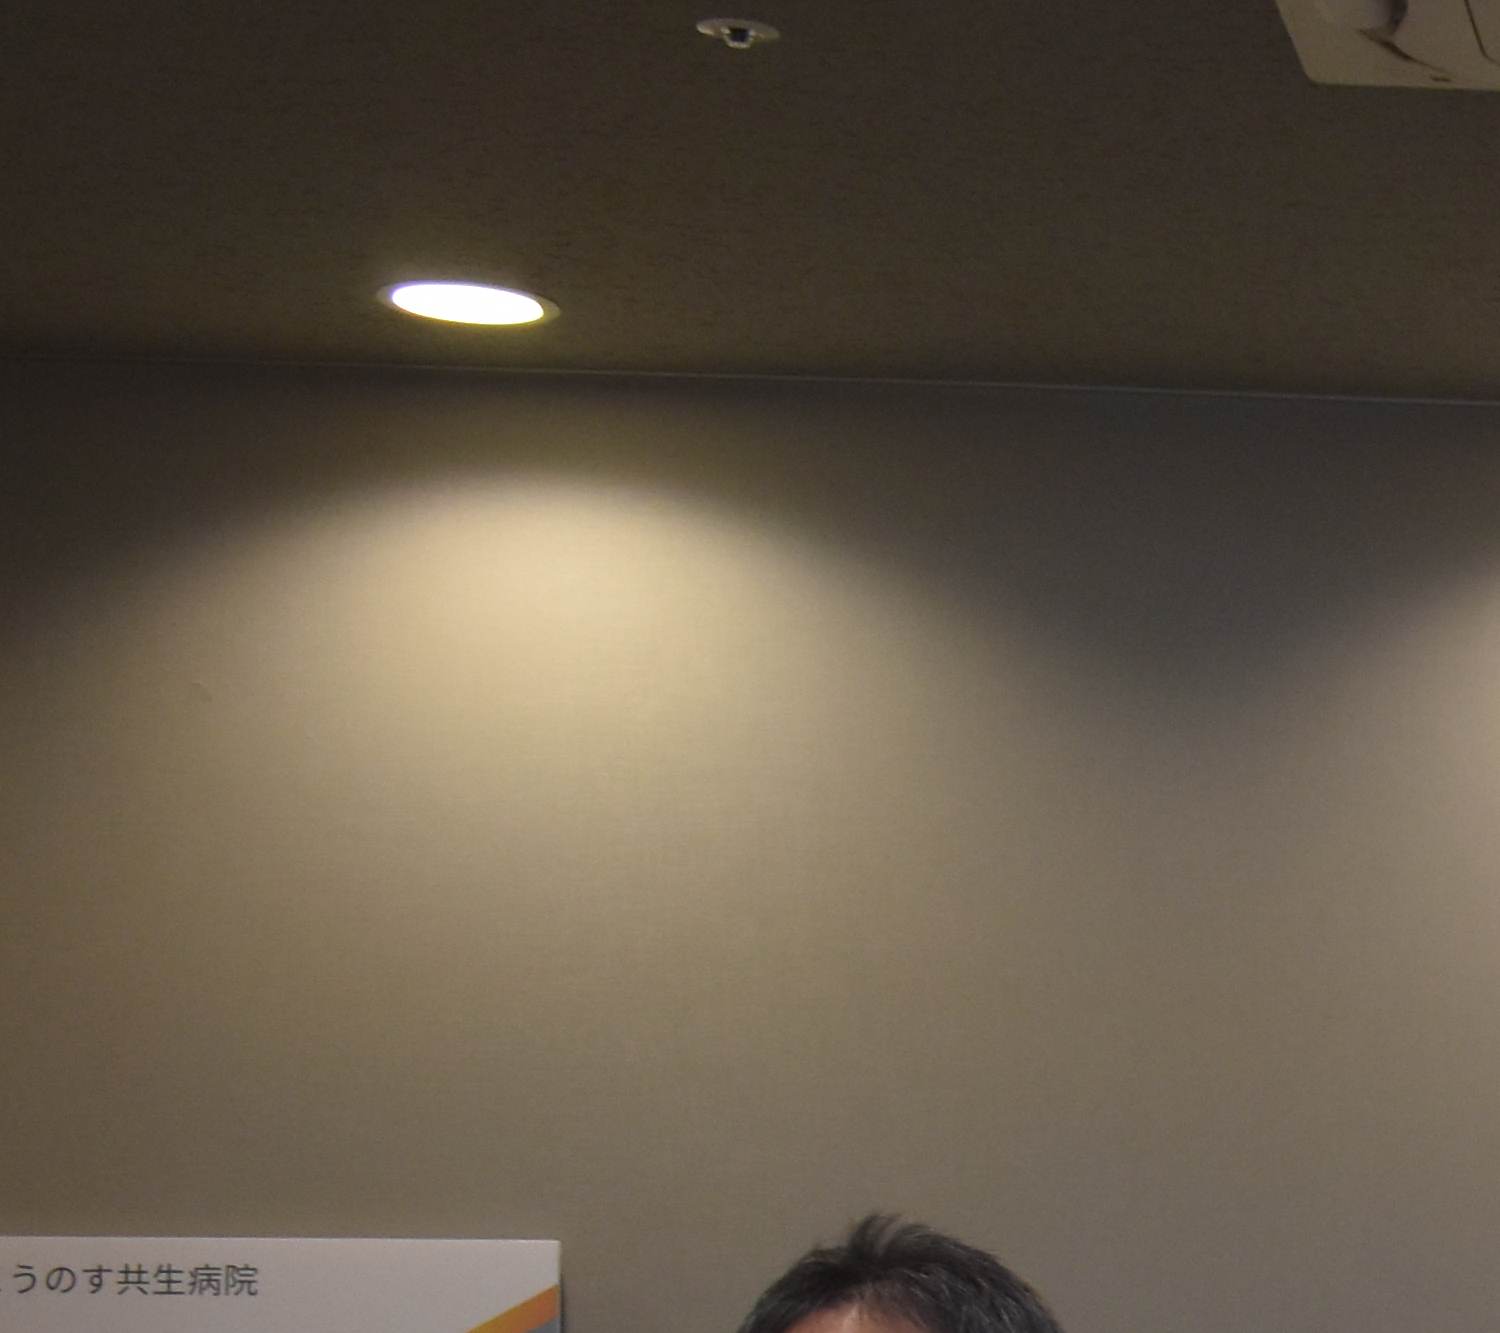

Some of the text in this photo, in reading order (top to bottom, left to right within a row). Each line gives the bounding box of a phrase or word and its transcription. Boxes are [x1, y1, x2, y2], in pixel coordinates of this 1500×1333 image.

[0, 1263, 259, 1297] うのす共生病院
